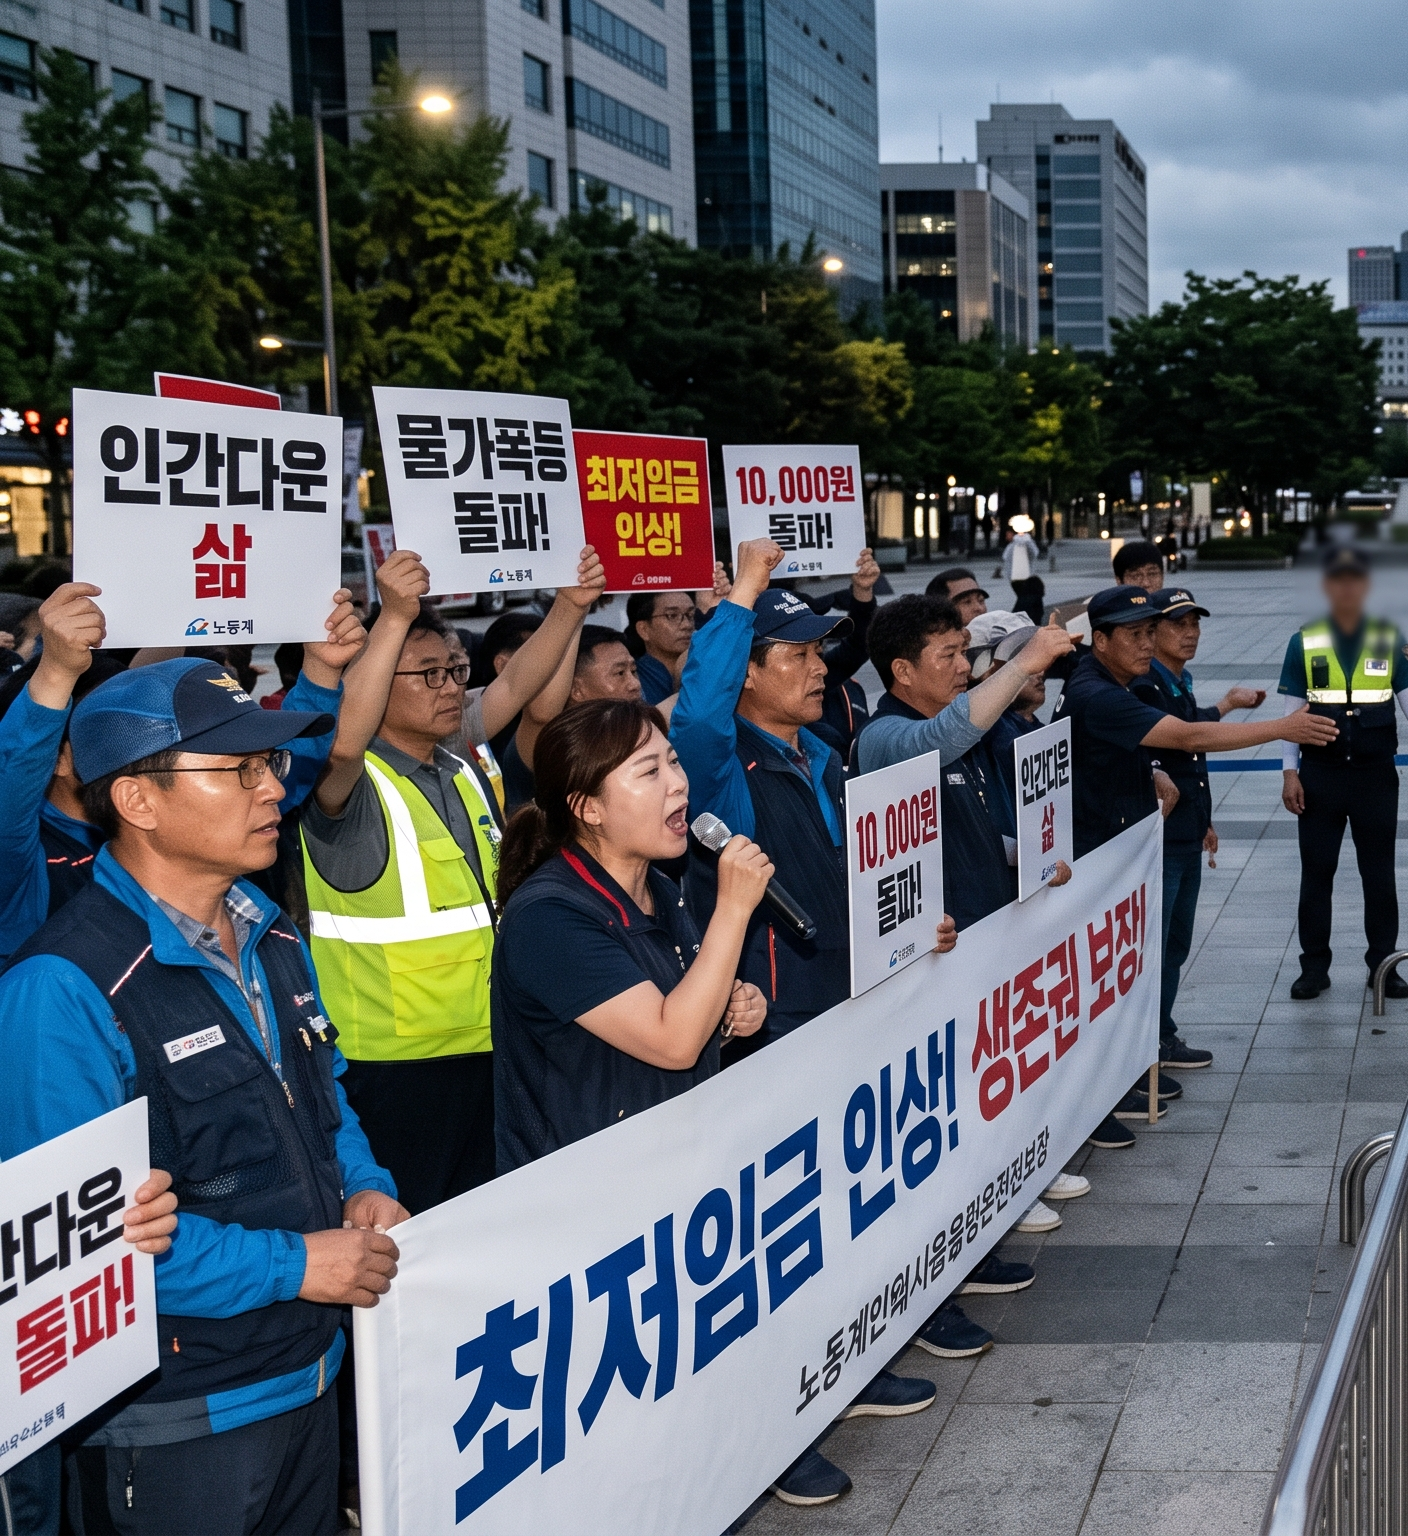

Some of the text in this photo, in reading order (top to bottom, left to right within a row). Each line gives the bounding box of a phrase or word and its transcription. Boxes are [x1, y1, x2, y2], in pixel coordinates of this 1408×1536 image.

[100, 424, 328, 514] 인간다운
[396, 413, 568, 483] 물가폭등
[586, 455, 700, 505] 최저임금
[735, 465, 855, 506] 10,000원
[453, 491, 551, 555] 돌파!
[615, 512, 682, 557] 인상!
[768, 512, 834, 552] 돌파!
[192, 523, 252, 599] 삶
[856, 785, 938, 873] 10,000원
[877, 861, 922, 938] 돌파!
[451, 882, 1147, 1526] 최저임금 인상! 생존권 보장!
[16, 1252, 136, 1395] 돌파!
